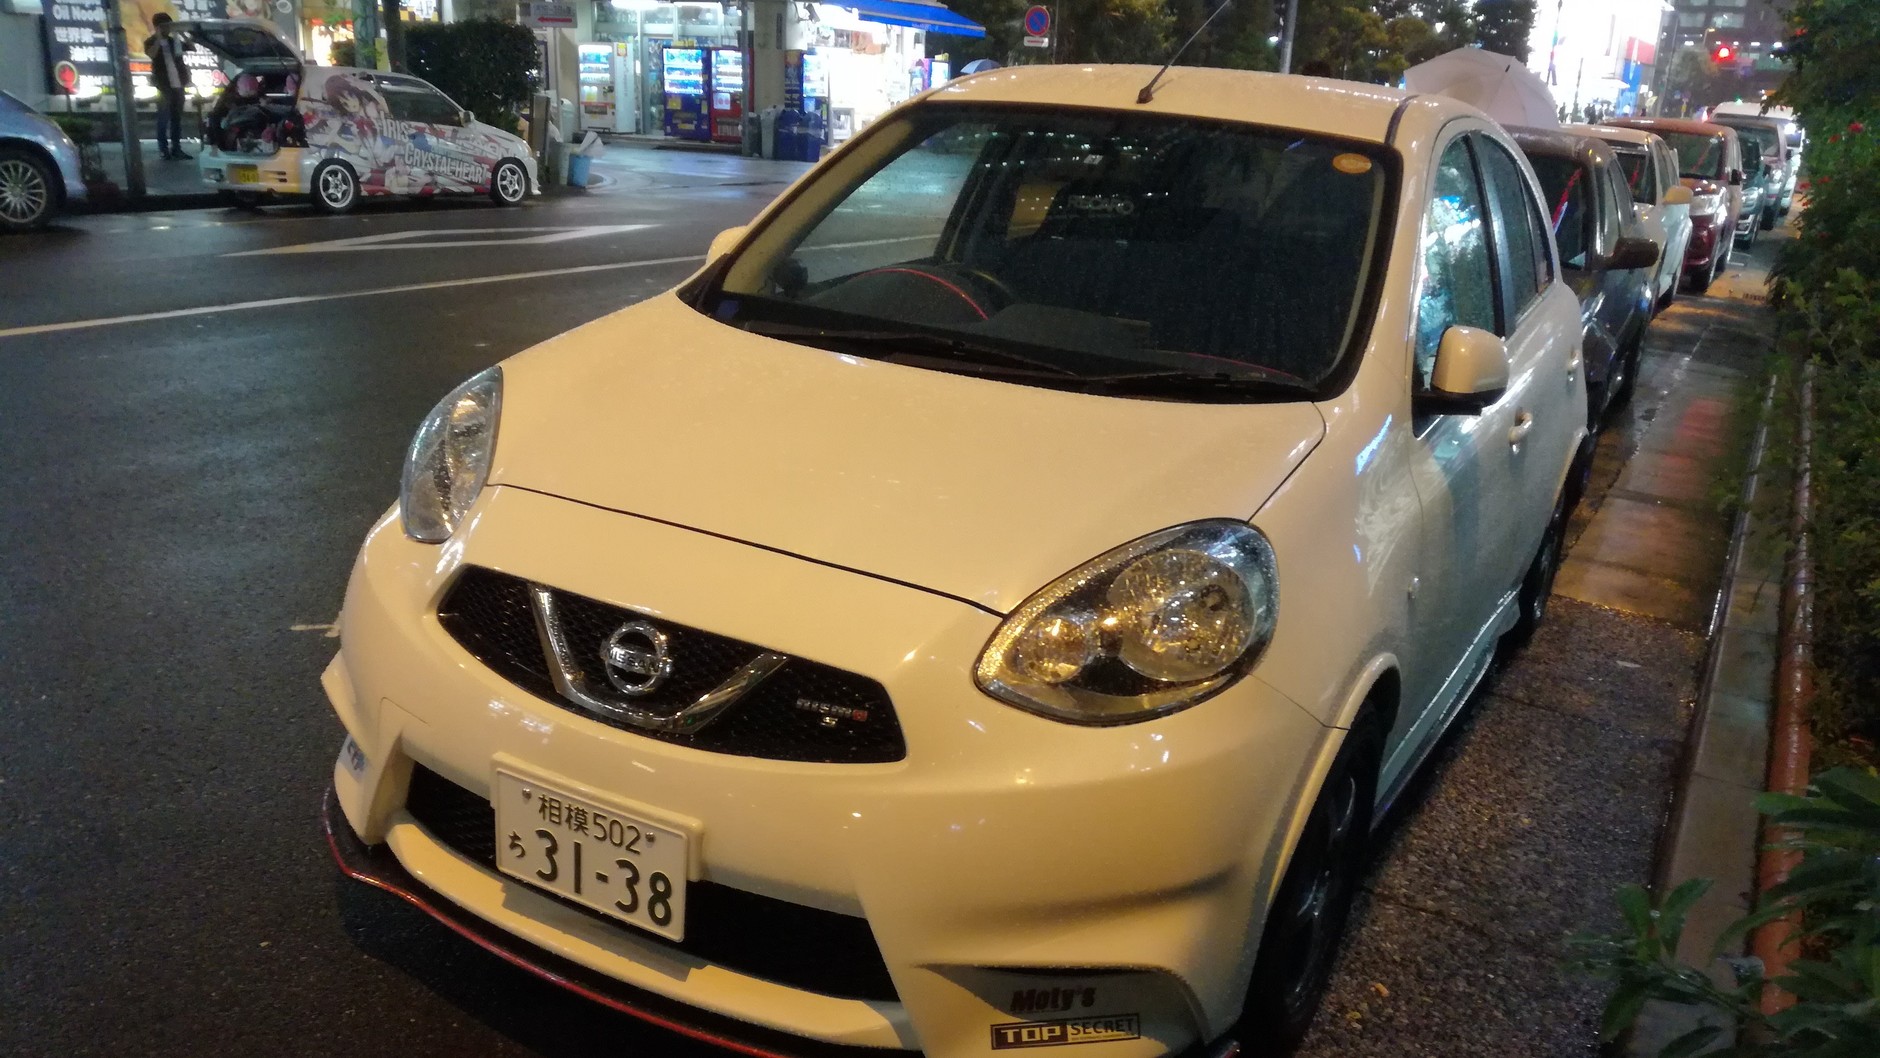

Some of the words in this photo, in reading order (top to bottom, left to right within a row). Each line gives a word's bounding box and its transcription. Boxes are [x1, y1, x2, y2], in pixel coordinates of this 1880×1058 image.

[535, 829, 672, 927] 31-38
[1000, 1025, 1061, 1043] TOP
[1070, 1018, 1134, 1036] SECRET
